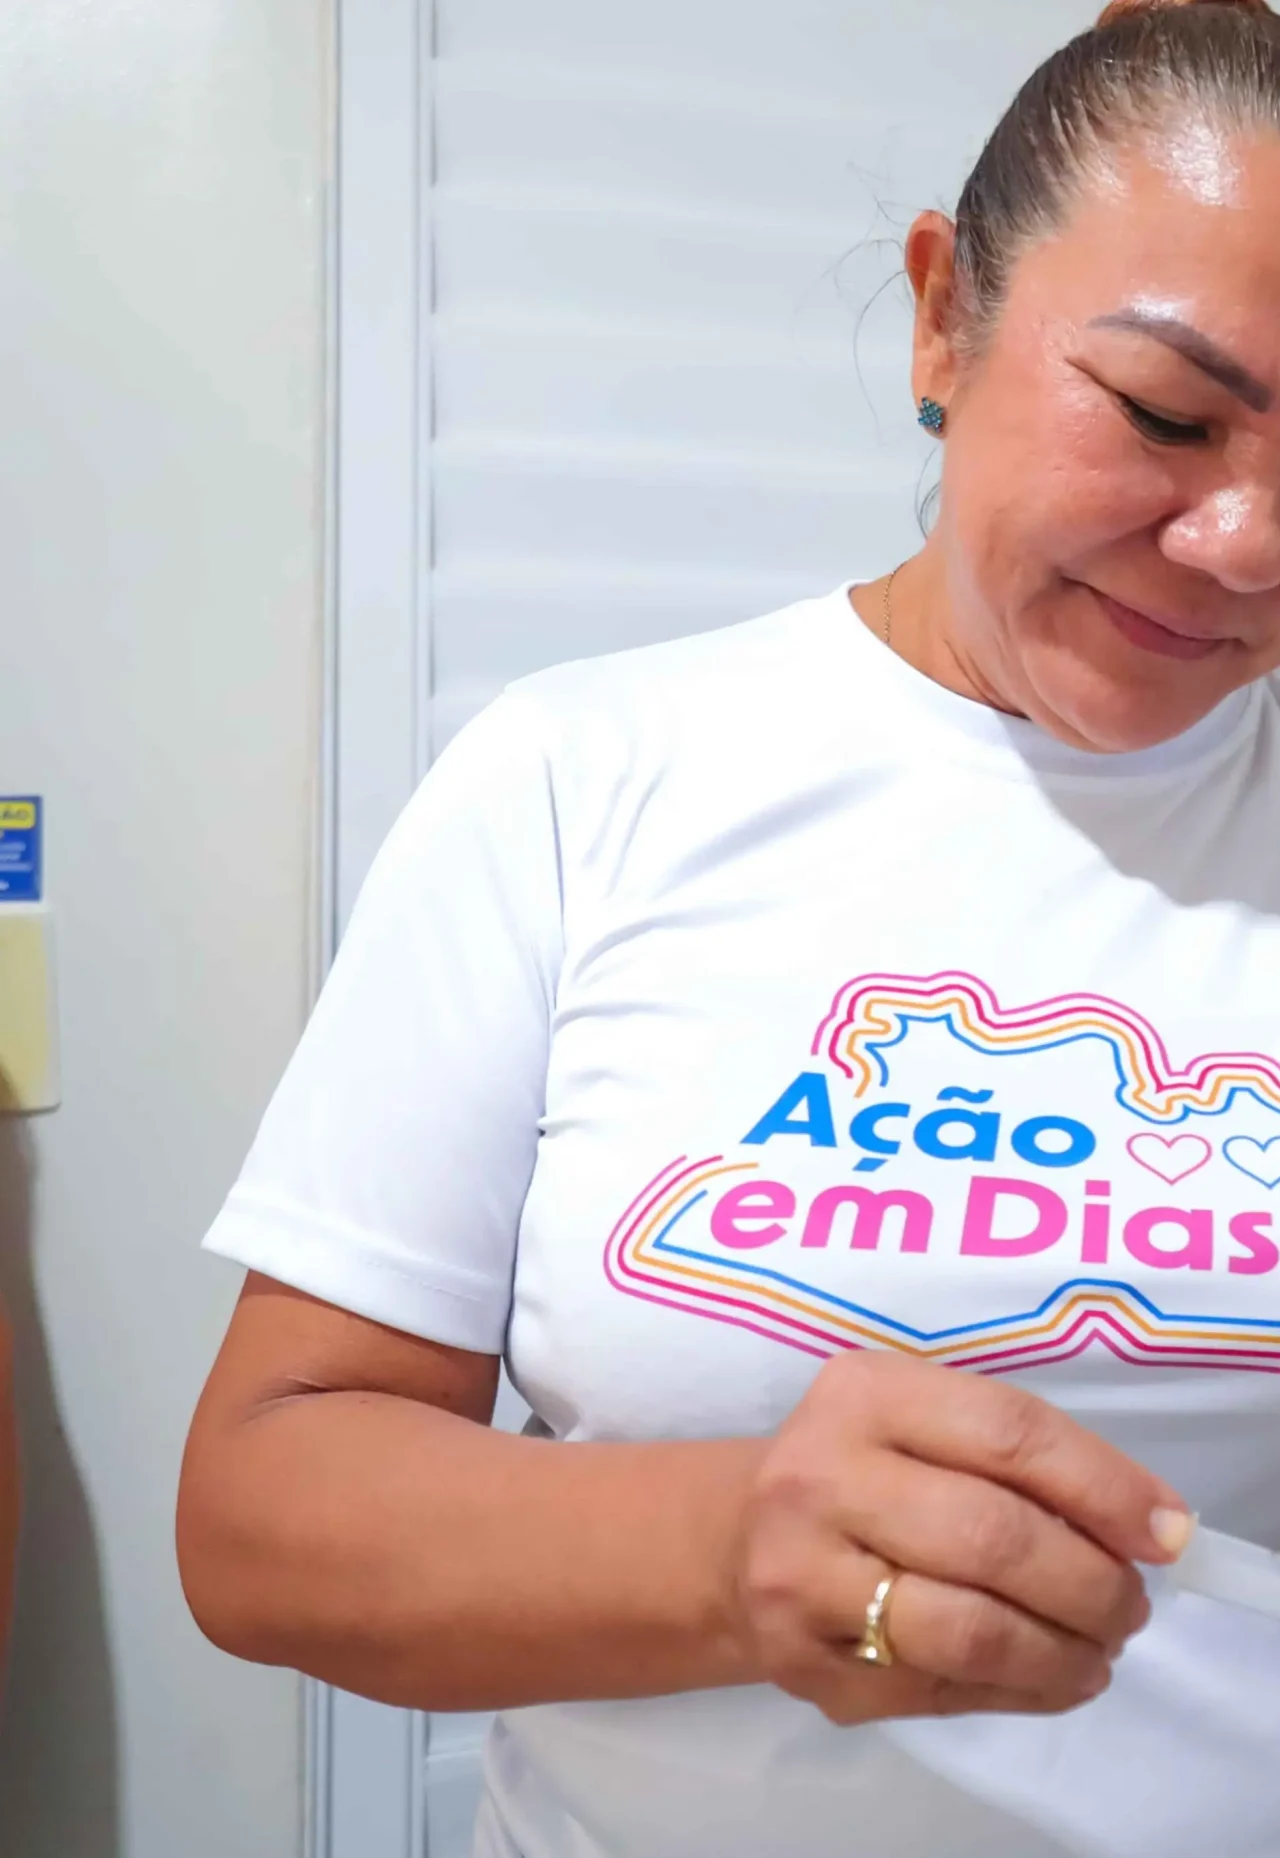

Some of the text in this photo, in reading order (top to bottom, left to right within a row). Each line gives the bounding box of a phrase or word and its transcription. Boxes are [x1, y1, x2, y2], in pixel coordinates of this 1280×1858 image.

[739, 1071, 1097, 1172] Ação
[710, 1175, 1280, 1275] em Dias
